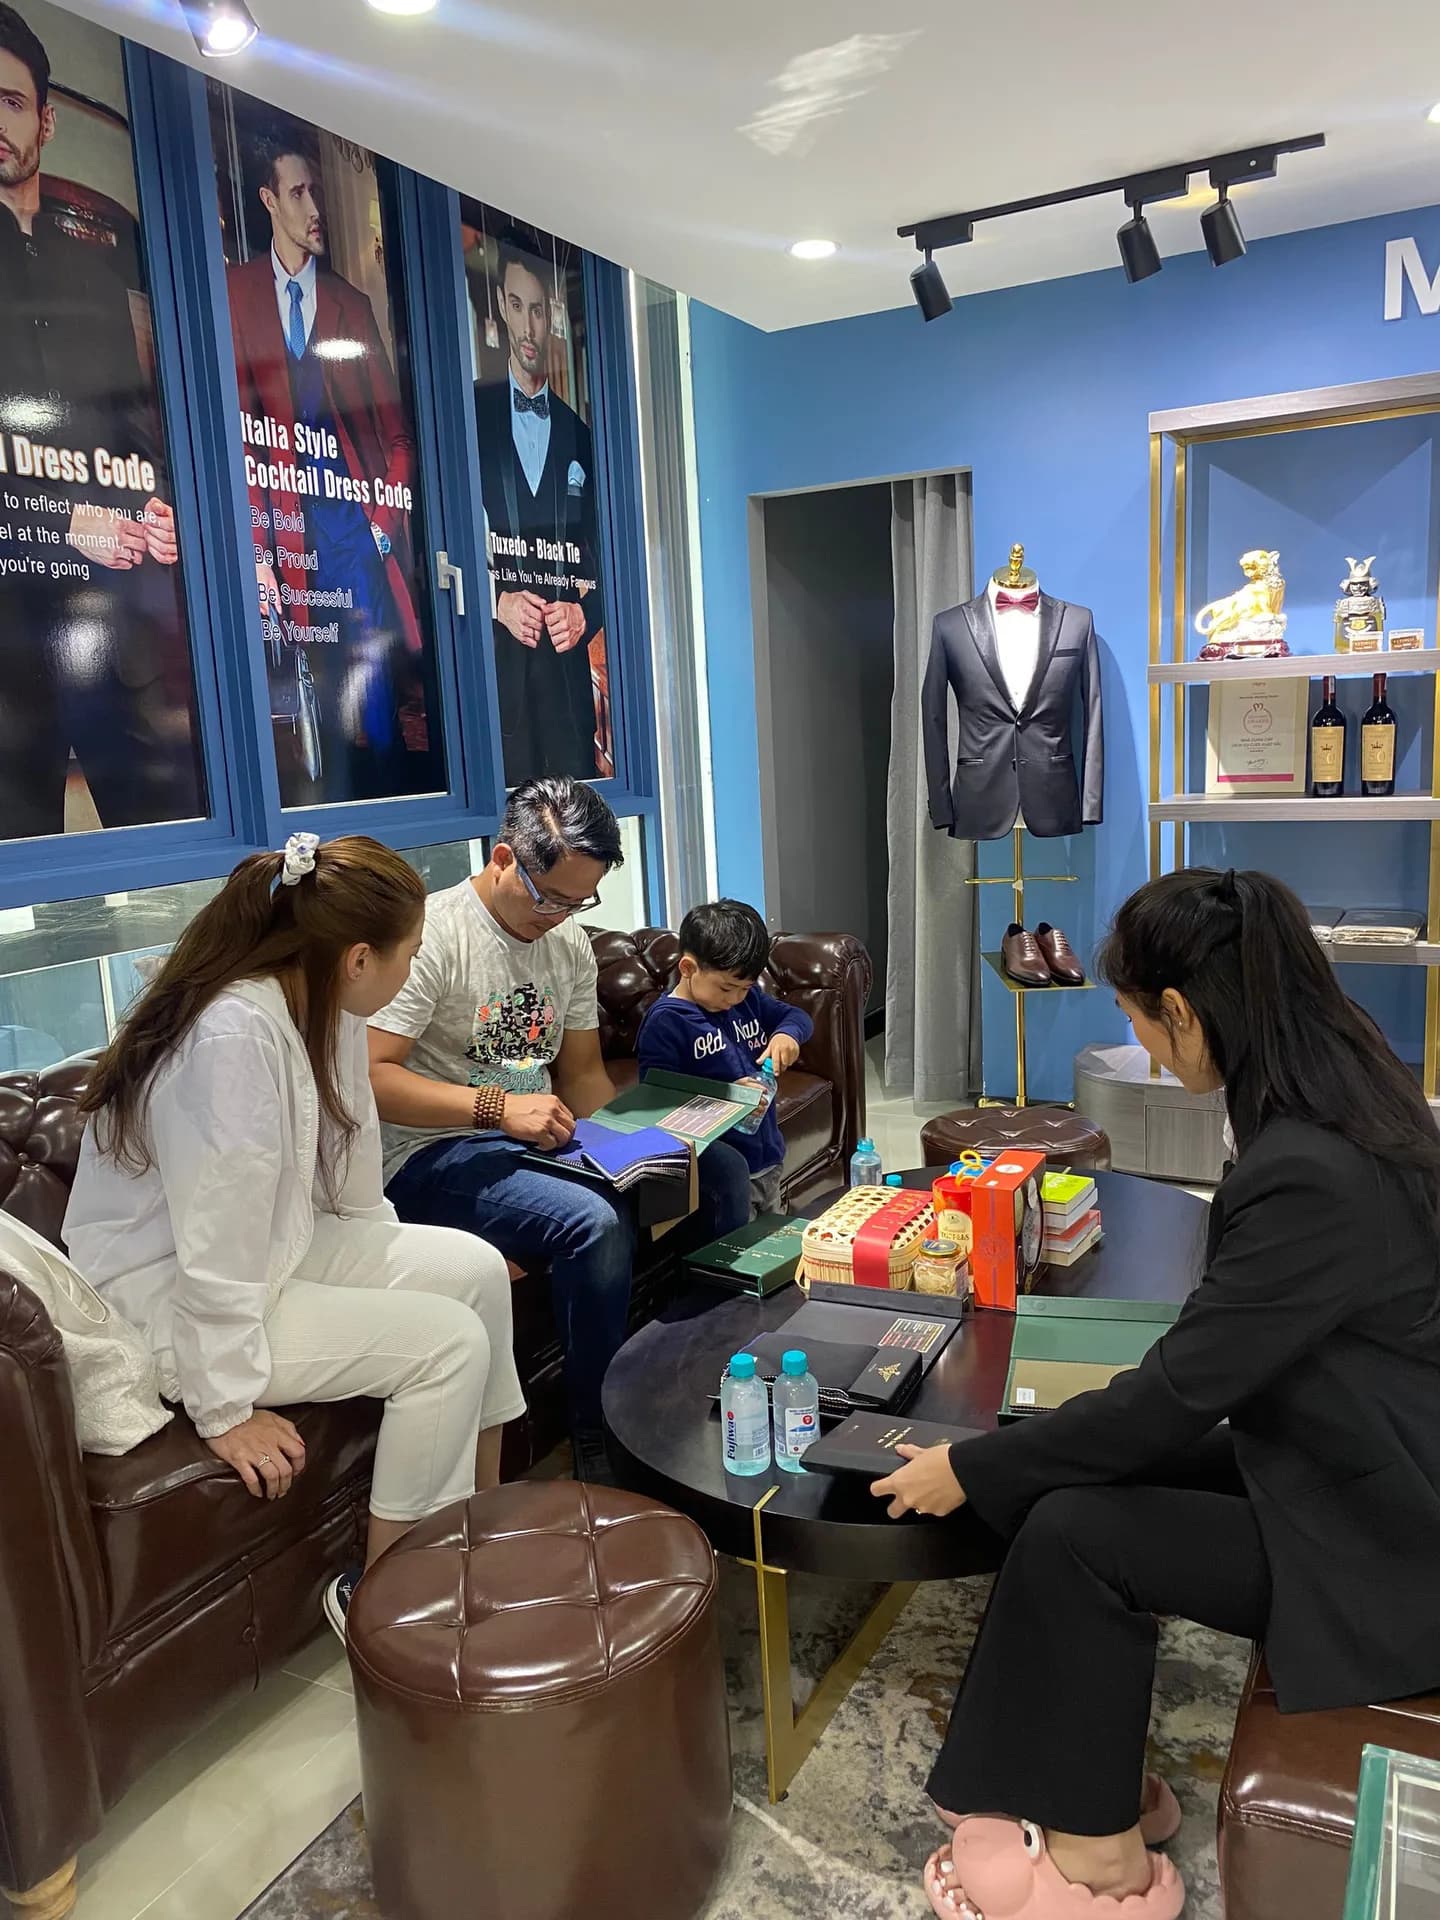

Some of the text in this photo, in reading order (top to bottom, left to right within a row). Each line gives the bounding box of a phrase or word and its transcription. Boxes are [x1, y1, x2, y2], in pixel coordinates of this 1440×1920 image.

[240, 411, 338, 459] Italia Style
[12, 434, 89, 484] Dress
[94, 447, 156, 493] Code
[244, 455, 412, 510] Cocktail Dress Code
[3, 491, 19, 509] to
[24, 495, 71, 515] reflect
[75, 501, 103, 518] who
[108, 507, 131, 524] you
[250, 505, 305, 533] Be Bold
[18, 526, 32, 542] at
[36, 526, 60, 544] the
[490, 532, 527, 557] Tuxedo
[536, 538, 564, 562] Black
[566, 542, 580, 564] Tie
[0, 556, 90, 581] you're going
[253, 544, 318, 571] Be Proud
[501, 567, 517, 582] Like
[518, 569, 532, 583] You
[544, 572, 569, 590] Already
[570, 575, 597, 590] Famous
[257, 583, 353, 609] Be Successful
[261, 619, 338, 643] Be Yourself
[694, 1018, 763, 1059] Old Nav
[727, 1419, 738, 1460] Fujiwa
